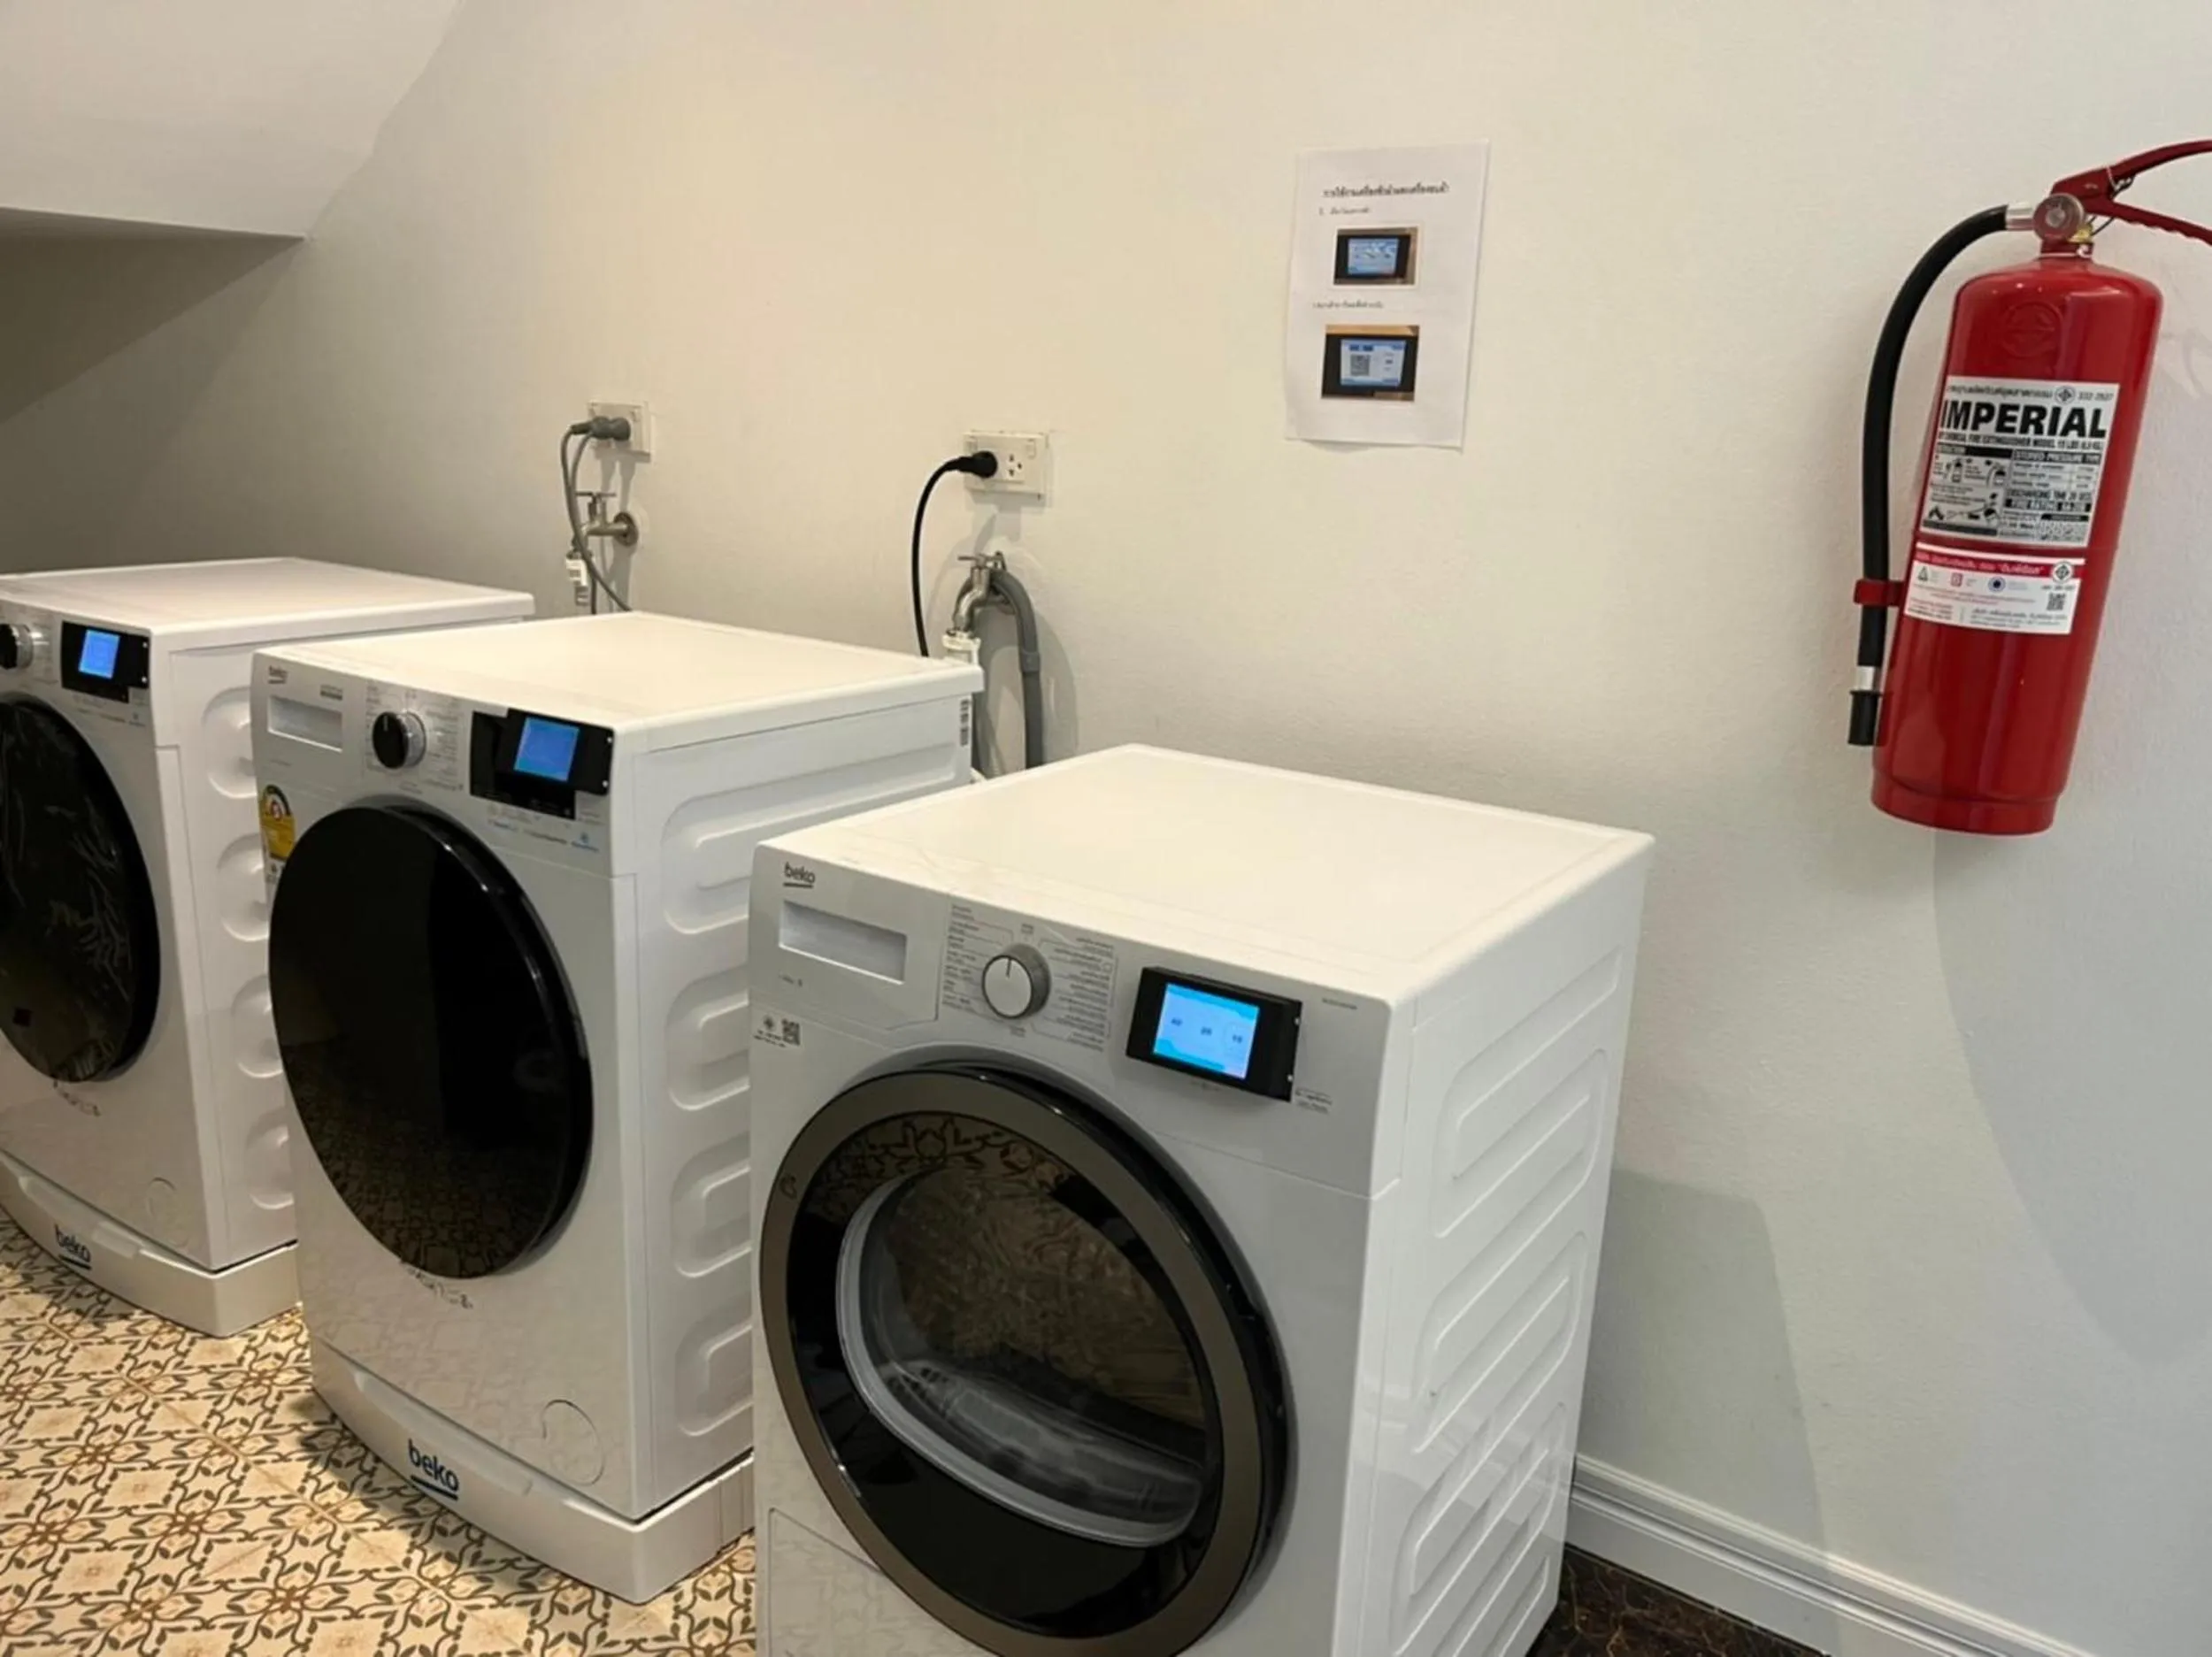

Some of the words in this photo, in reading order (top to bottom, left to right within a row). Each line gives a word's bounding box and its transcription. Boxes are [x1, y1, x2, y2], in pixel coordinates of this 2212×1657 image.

[1940, 400, 2108, 439] IMPERIAL
[783, 862, 816, 885] beko
[55, 1224, 91, 1263] beko
[408, 1438, 459, 1492] beko
